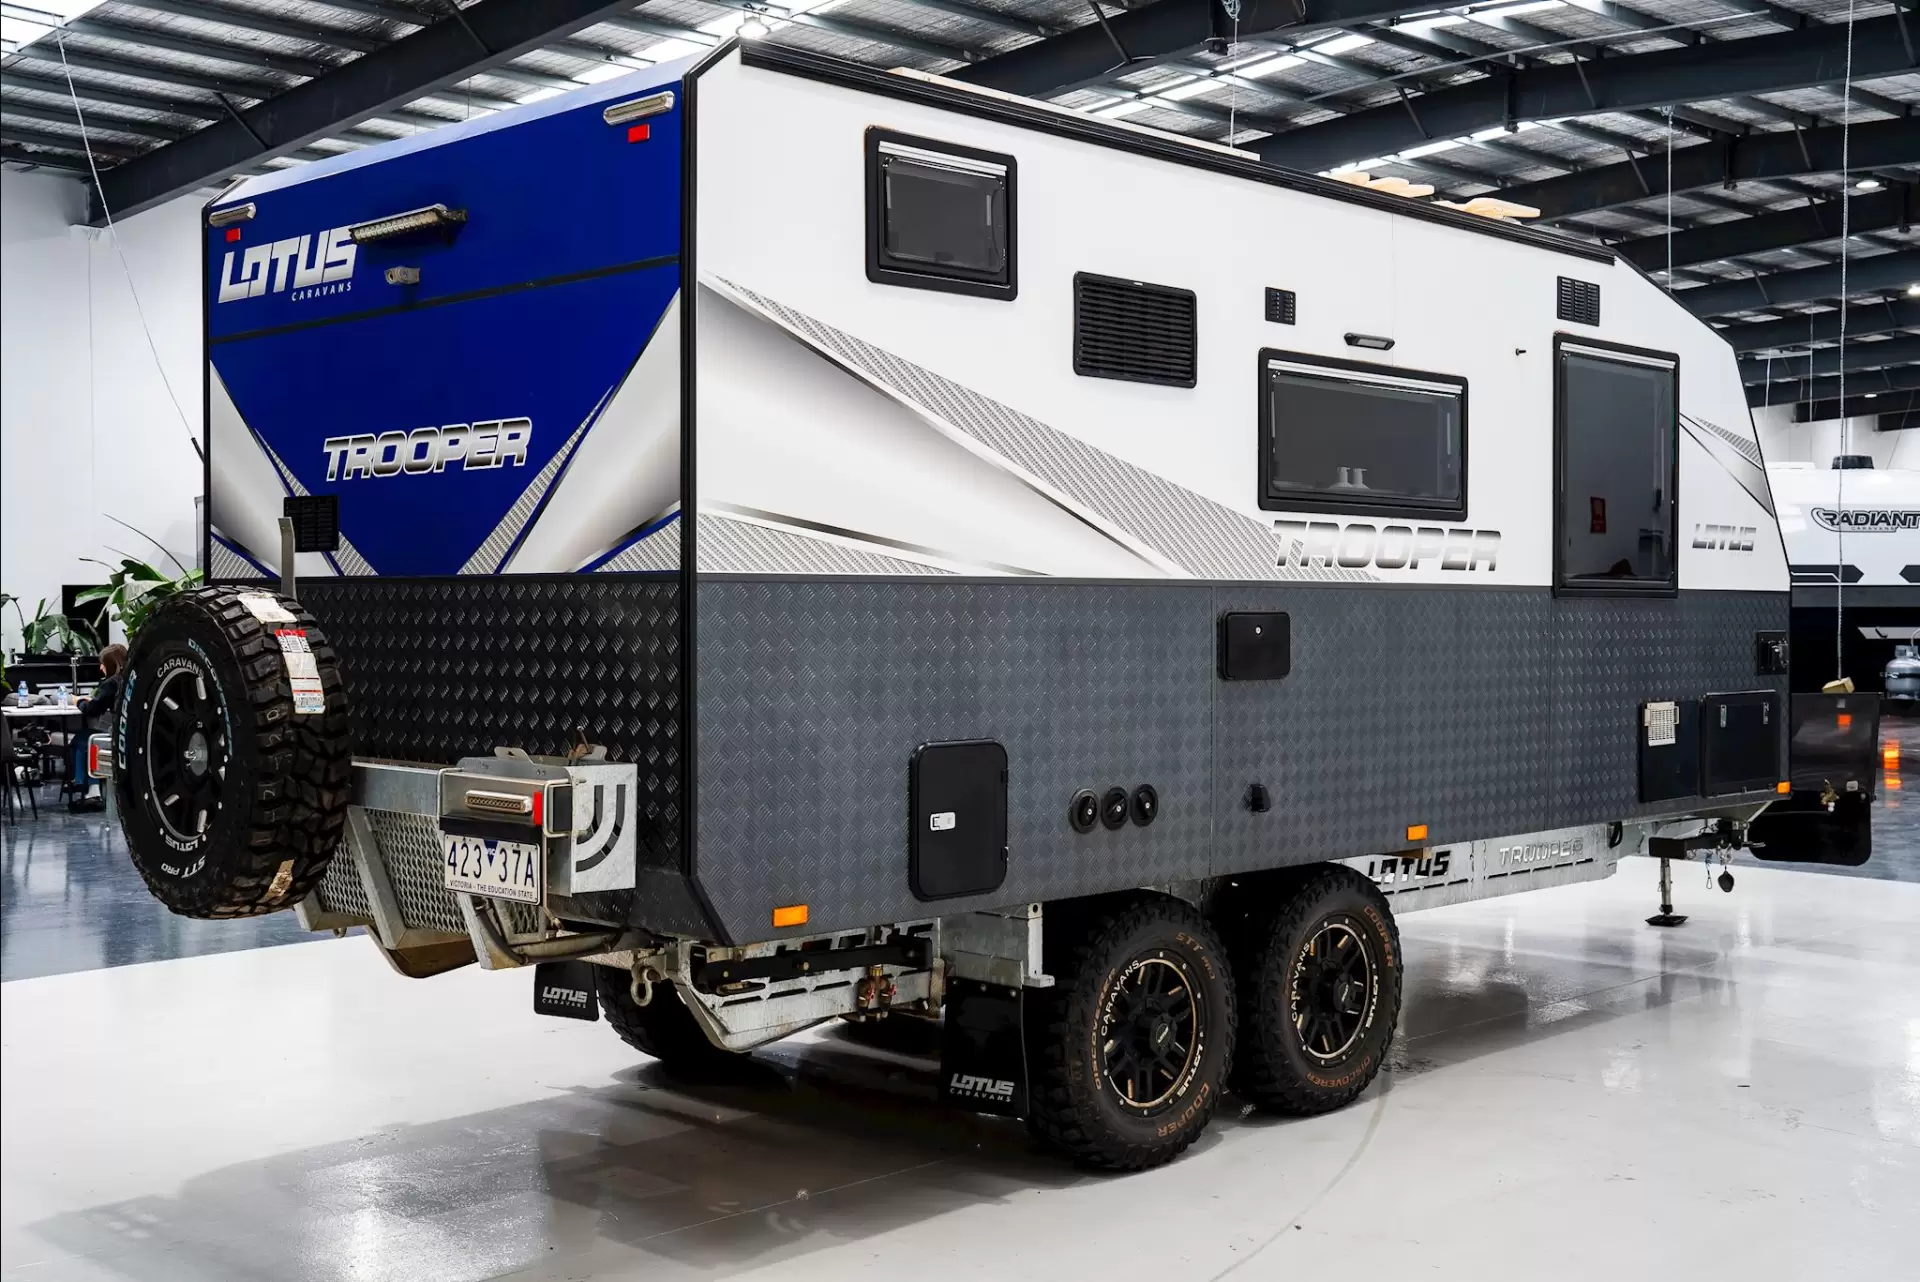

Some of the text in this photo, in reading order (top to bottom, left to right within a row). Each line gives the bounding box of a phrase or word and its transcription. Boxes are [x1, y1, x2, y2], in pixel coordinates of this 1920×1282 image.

[218, 224, 358, 304] LOTUS
[291, 282, 353, 302] CARAVANS
[323, 416, 533, 482] TROOPER
[1692, 523, 1757, 552] LOTUS
[1816, 511, 1920, 529] RADIANT
[1273, 519, 1502, 572] TROOPER
[156, 656, 205, 681] CARAVANS
[117, 668, 138, 771] COOPER
[165, 835, 200, 853] LOTUS
[160, 854, 206, 879] STT PRO
[447, 841, 535, 888] 423 37A
[1367, 849, 1451, 885] LOTUS
[449, 879, 473, 889] VICTORIA
[477, 883, 487, 893] THE
[487, 884, 517, 897] EDUCATION
[517, 889, 534, 900] STATE
[1175, 931, 1205, 952] STT
[1363, 904, 1394, 968] COOPER
[542, 985, 588, 1003] LOTUS
[1100, 958, 1141, 1037] CARAVANS
[1289, 941, 1311, 1023] CARAVANS
[1364, 974, 1380, 1029] LOTUS
[950, 1072, 1015, 1096] LOTUS
[1176, 1043, 1205, 1098] LOTUS
[1306, 1054, 1371, 1089] DISCOVERER
[949, 1086, 1012, 1103] CARAVANS
[1156, 1079, 1211, 1138] COOPER
